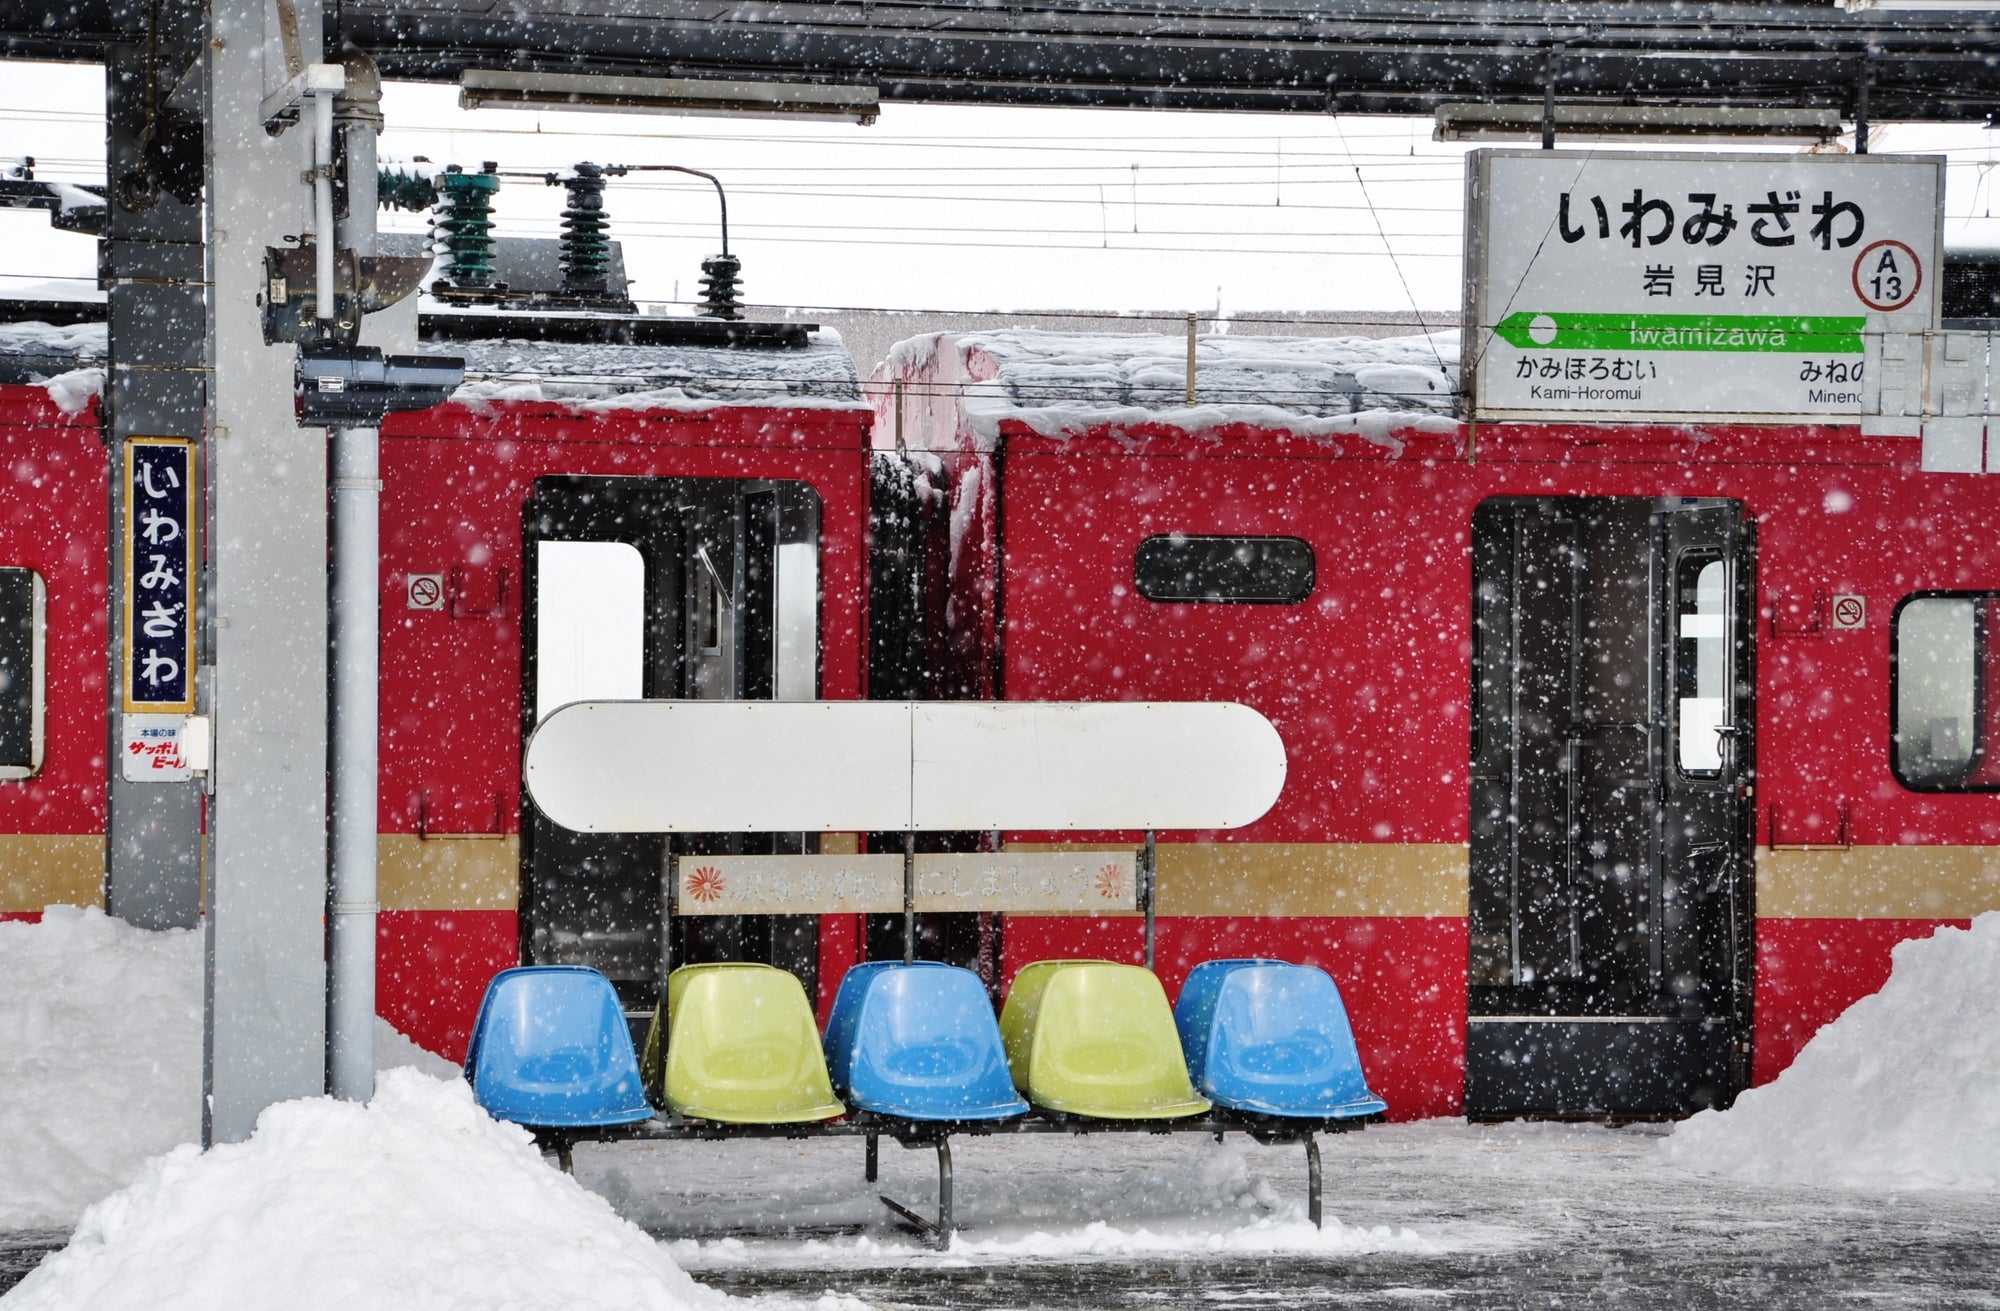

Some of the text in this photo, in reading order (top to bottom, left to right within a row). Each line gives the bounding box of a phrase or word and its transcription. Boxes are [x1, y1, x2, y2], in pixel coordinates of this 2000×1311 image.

[1558, 190, 1865, 250] いわみざわ
[1877, 250, 1897, 274] A
[1643, 264, 1776, 297] 岩見沢
[1870, 276, 1902, 301] 13
[1630, 320, 1786, 348] Iwamizawa
[1516, 357, 1657, 381] かみほろむい
[1530, 386, 1642, 401] Kami-Horomui
[140, 463, 184, 685] いわみざわ
[140, 728, 176, 738] 本場の味
